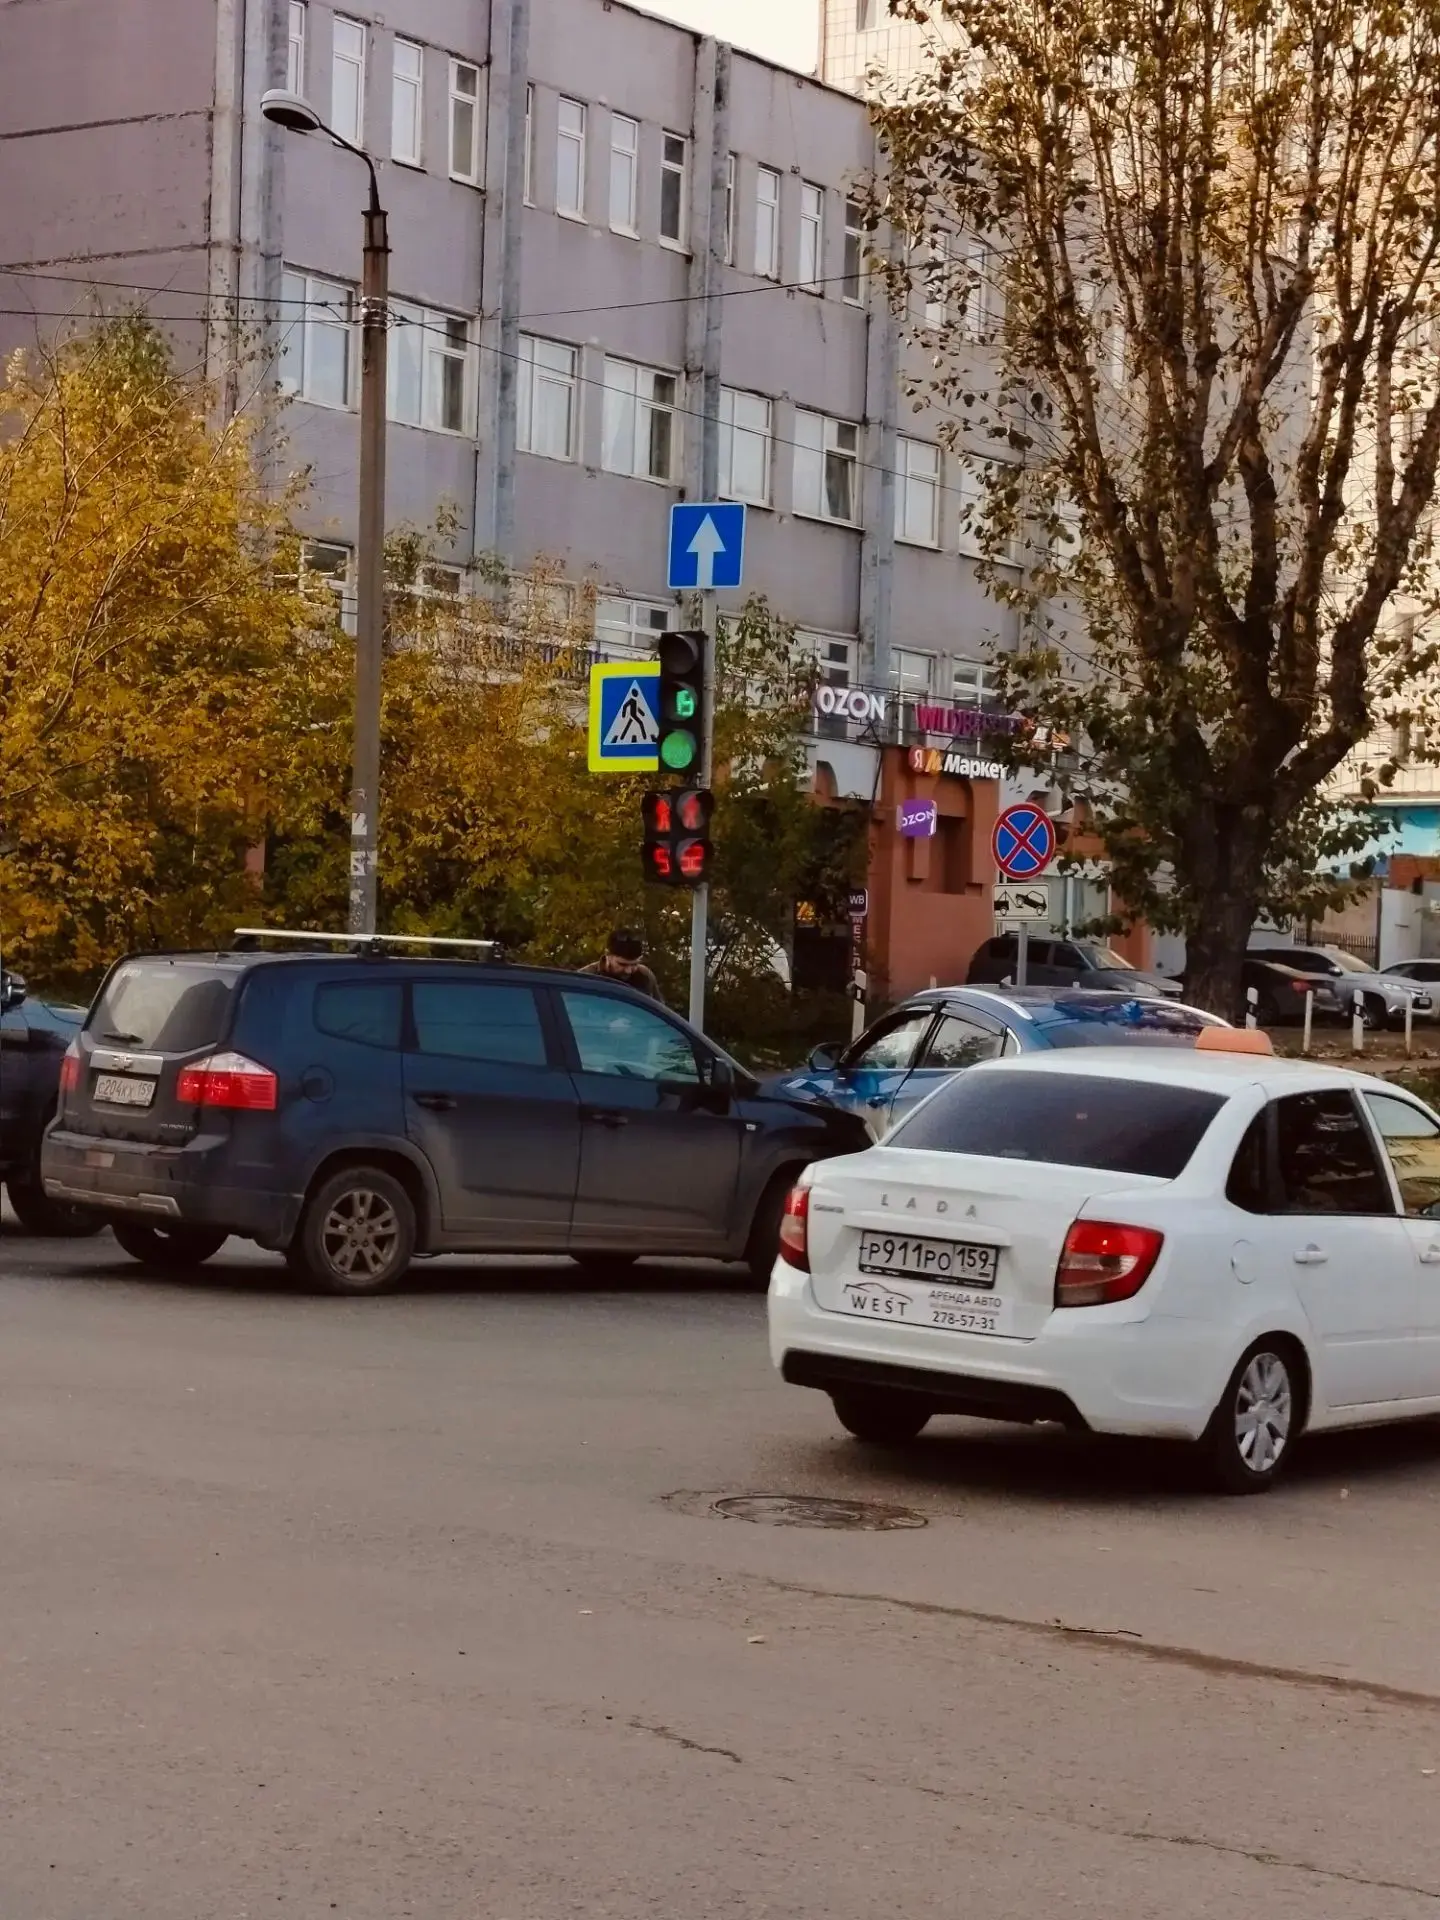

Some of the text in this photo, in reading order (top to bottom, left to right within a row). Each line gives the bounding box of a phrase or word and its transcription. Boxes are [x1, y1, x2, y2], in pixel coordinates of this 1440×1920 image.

[817, 686, 885, 721] OZON
[944, 754, 1009, 779] Маркет
[849, 894, 865, 905] WB
[881, 1193, 977, 1218] LADA
[851, 1293, 908, 1317] WEST
[928, 1290, 1002, 1308] АРЕНДА АВТО
[932, 1310, 996, 1330] 278-57-31
